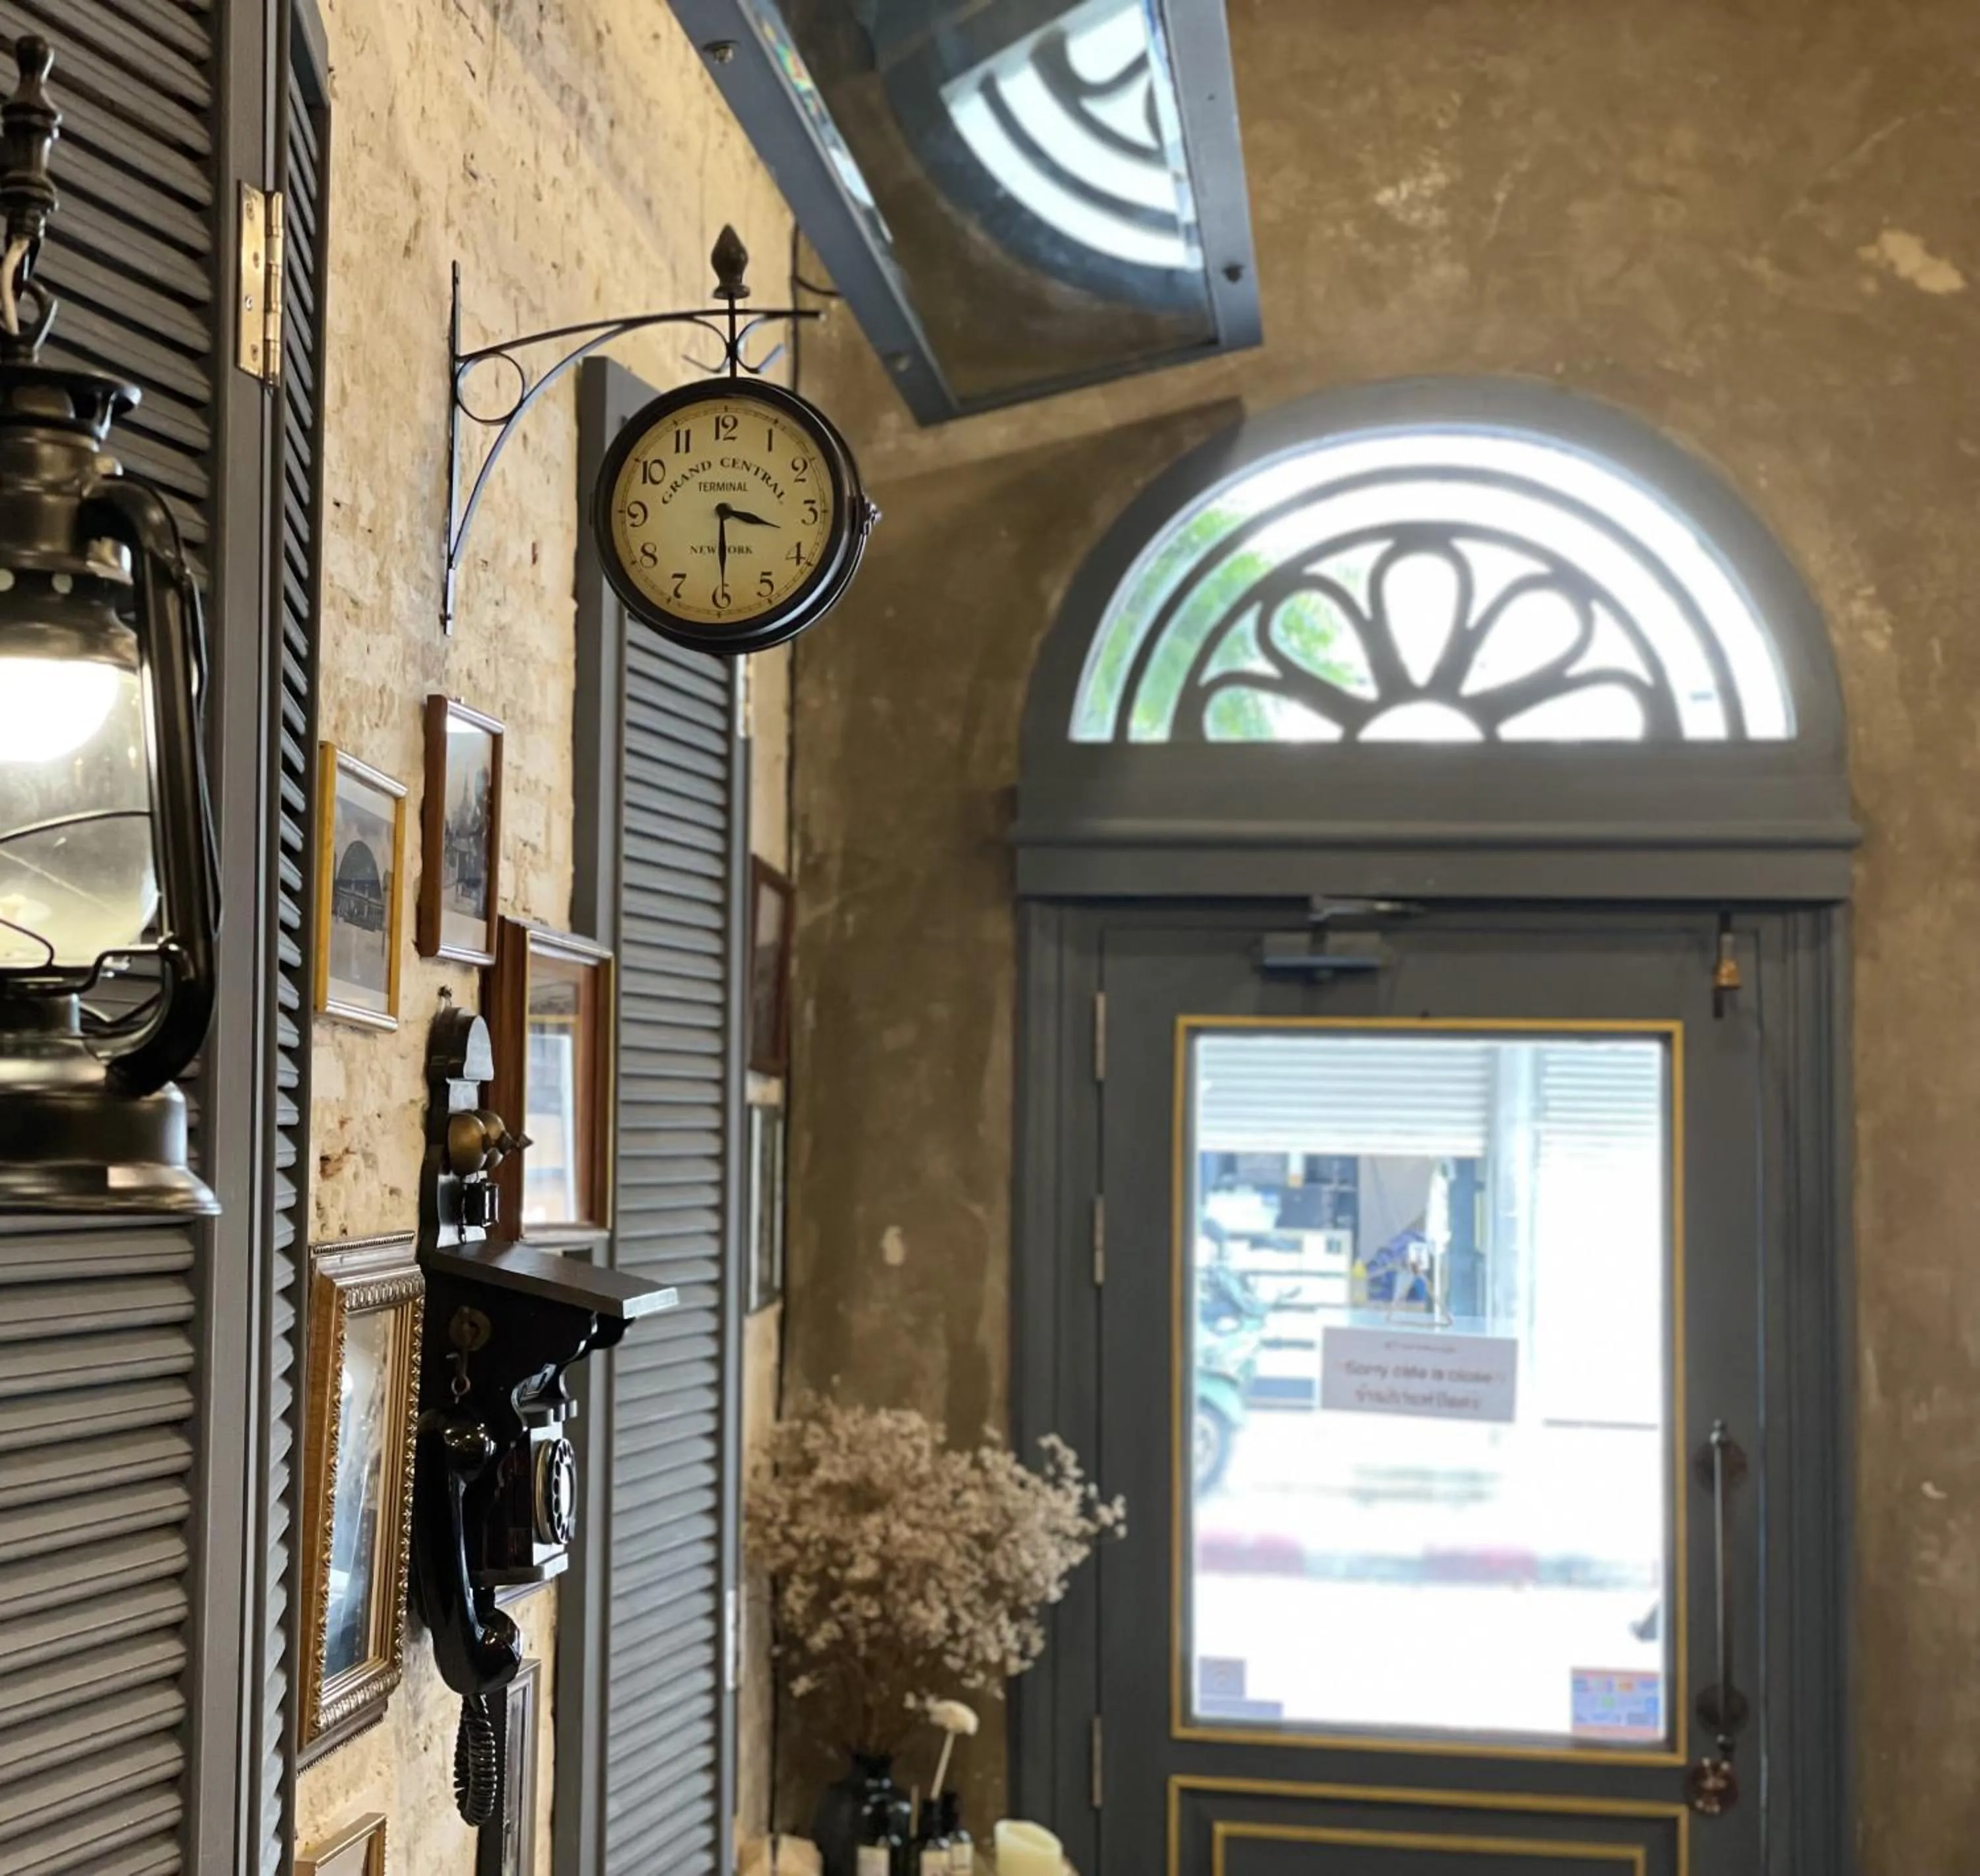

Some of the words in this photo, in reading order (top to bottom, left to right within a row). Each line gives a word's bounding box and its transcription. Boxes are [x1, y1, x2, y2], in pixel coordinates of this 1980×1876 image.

[674, 428, 691, 454] 11
[713, 414, 739, 442] 12
[767, 428, 774, 453] 1
[642, 459, 666, 485] 10
[661, 459, 712, 505] GRAND
[719, 456, 785, 506] CENTRAL
[791, 455, 809, 483] 2
[698, 481, 748, 493] TERMINAL
[626, 500, 648, 528] 9
[801, 499, 818, 525] 3
[639, 542, 658, 569] 8
[690, 545, 717, 555] NEW
[720, 545, 753, 555] ORK
[785, 541, 805, 566] 4
[671, 572, 687, 599] 7
[711, 582, 731, 609] 6
[756, 570, 775, 597] 5
